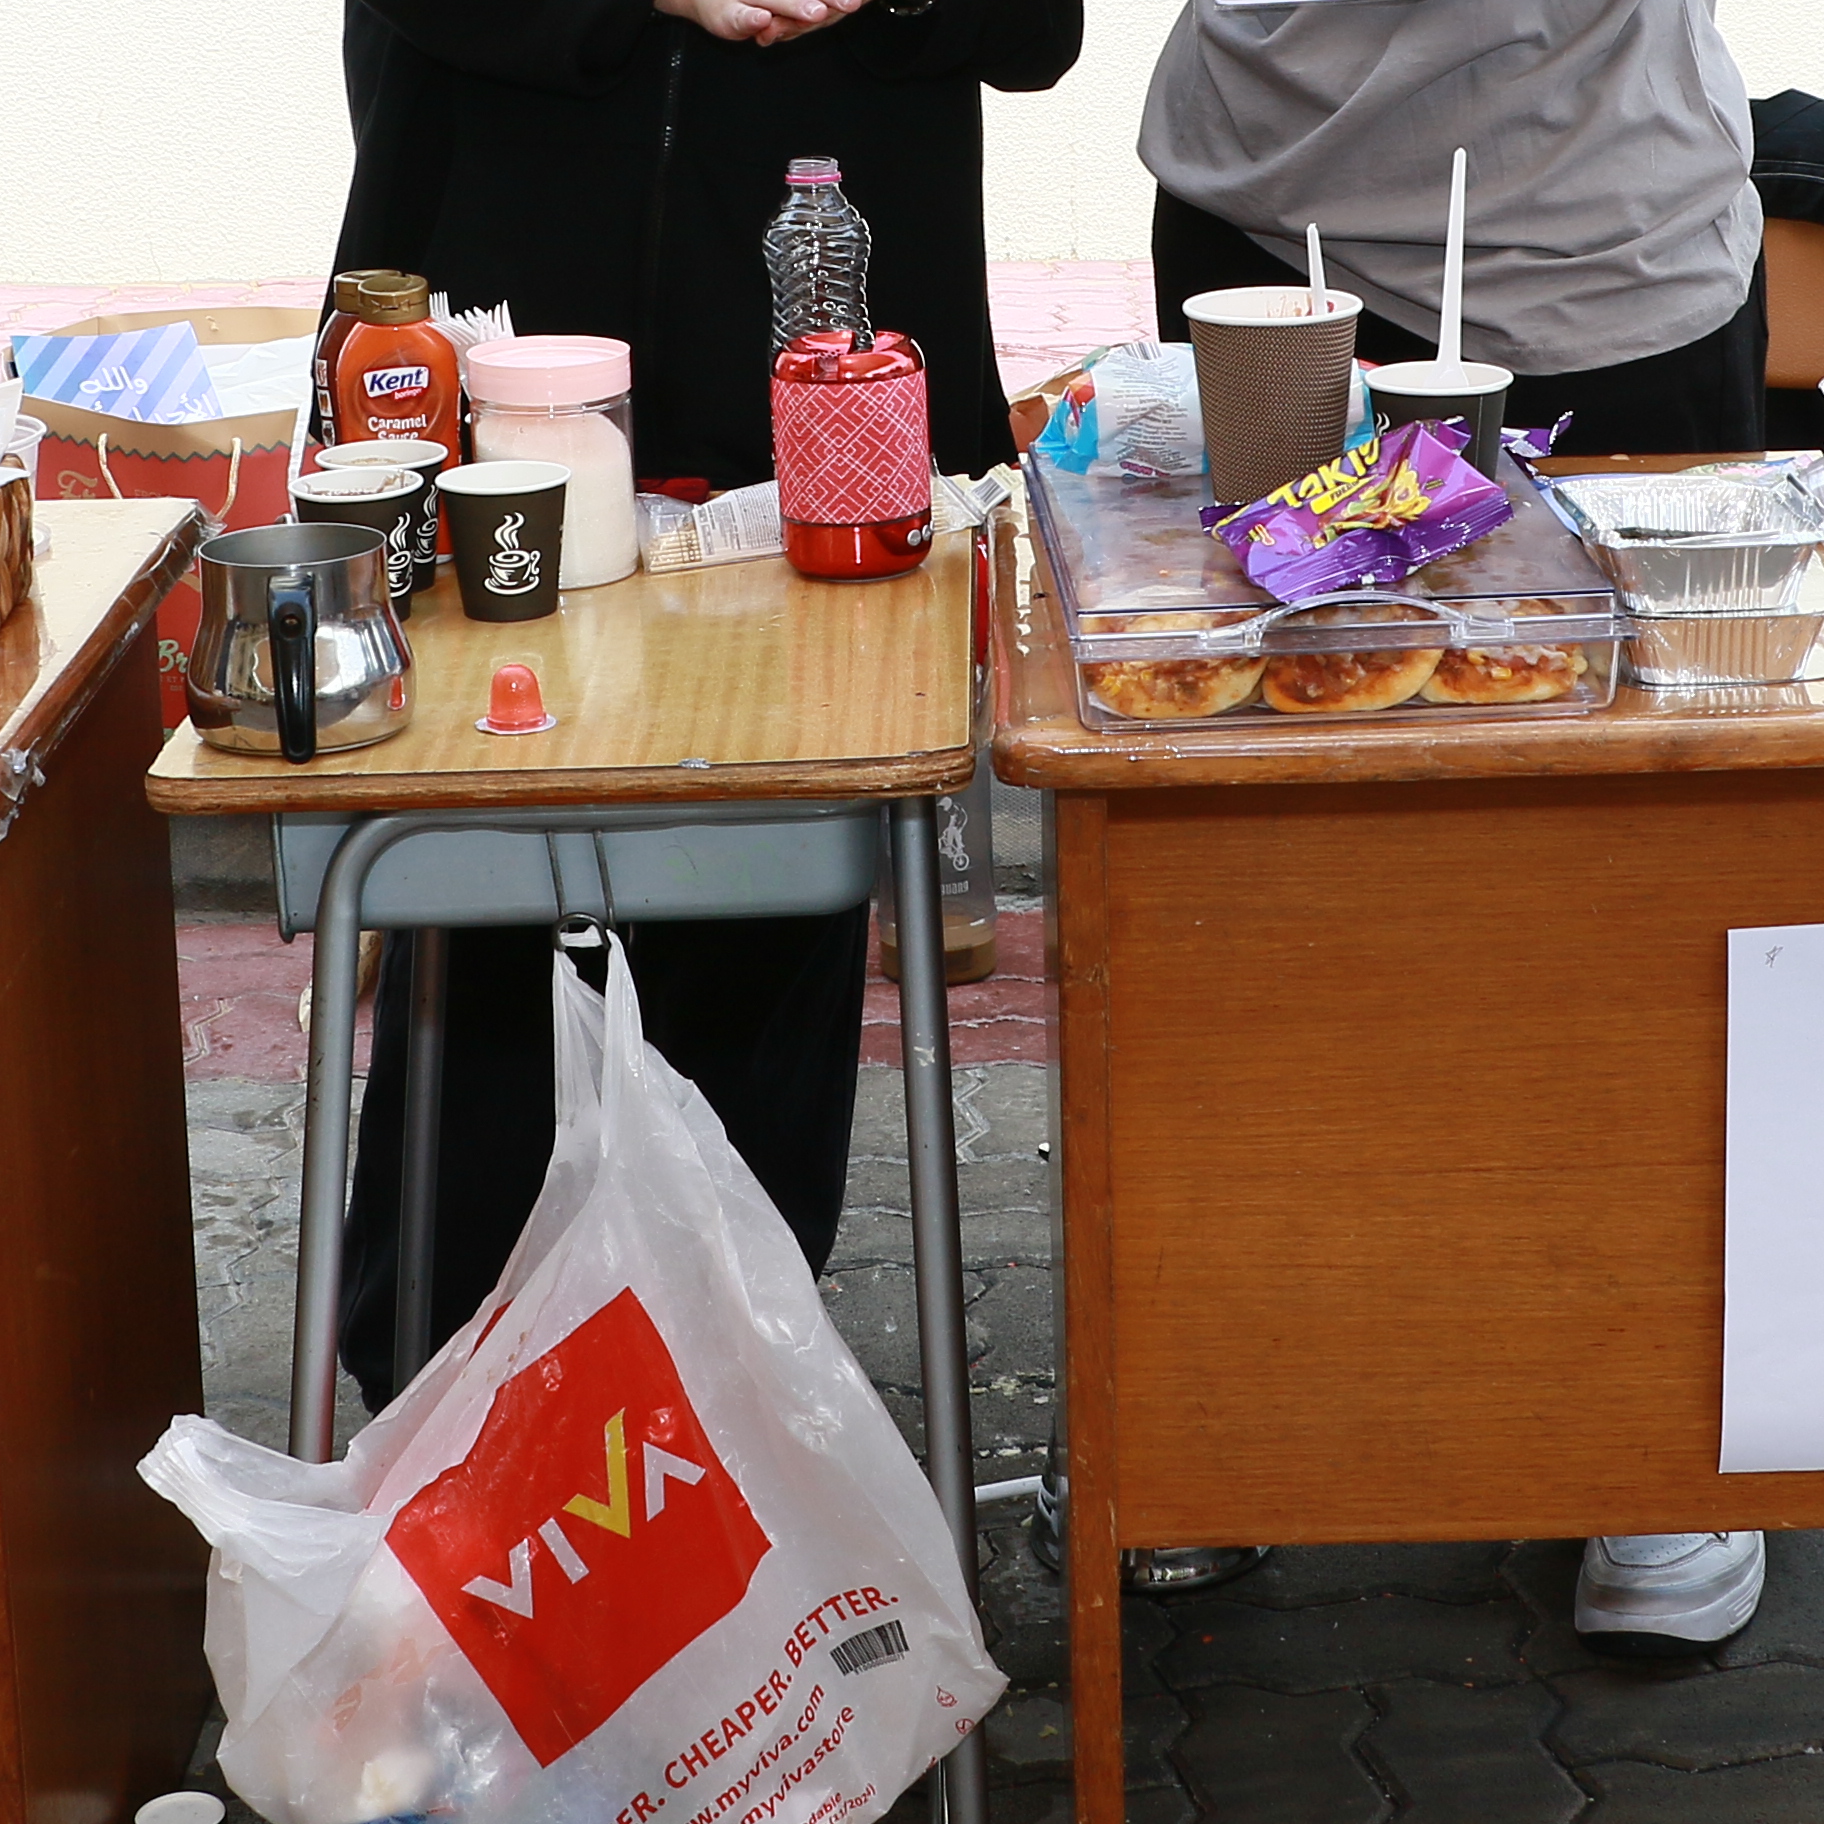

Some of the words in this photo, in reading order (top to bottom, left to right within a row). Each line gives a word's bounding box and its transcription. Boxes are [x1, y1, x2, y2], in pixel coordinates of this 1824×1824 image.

[79, 365, 149, 394] والله
[369, 368, 423, 393] Kent
[367, 414, 428, 433] Caramel
[460, 1407, 707, 1619] VIVA
[664, 1669, 793, 1790] CHEAPER.
[783, 1586, 899, 1668] BETTER.
[684, 1684, 826, 1824] w.myviva.com
